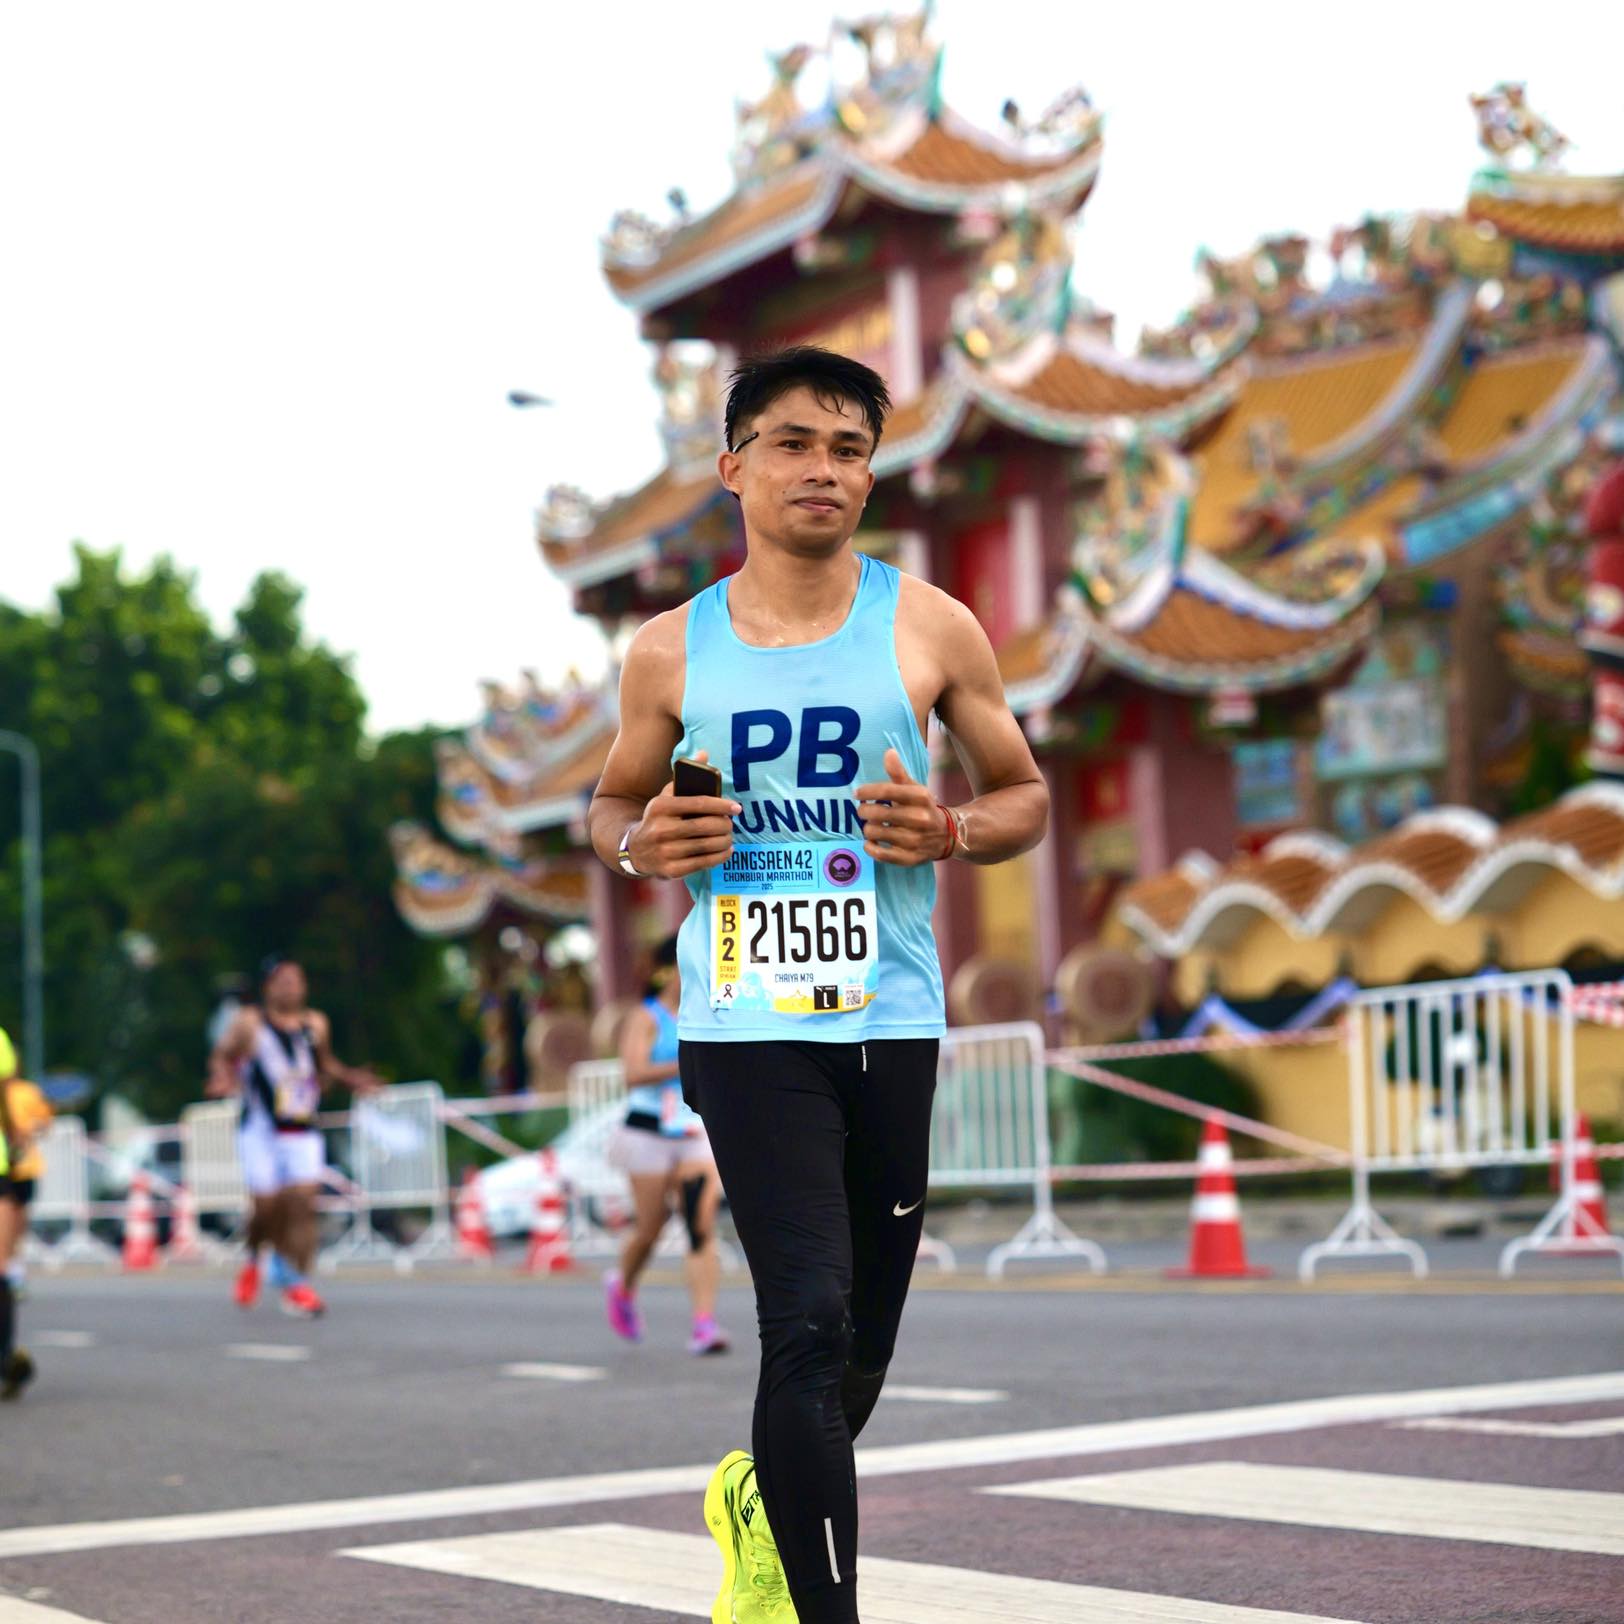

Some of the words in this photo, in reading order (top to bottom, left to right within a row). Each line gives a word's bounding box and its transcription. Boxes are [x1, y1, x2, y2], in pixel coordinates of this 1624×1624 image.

[731, 705, 861, 793] PB
[733, 799, 892, 835] UNNIN
[794, 849, 813, 869] 42
[723, 871, 765, 883] CHONBURI
[766, 871, 813, 882] MARATHON
[720, 899, 737, 907] BLOCK
[721, 911, 736, 933] B
[747, 897, 868, 964] 21566
[722, 937, 735, 962] 2
[799, 972, 814, 983] M79
[823, 991, 830, 1008] L
